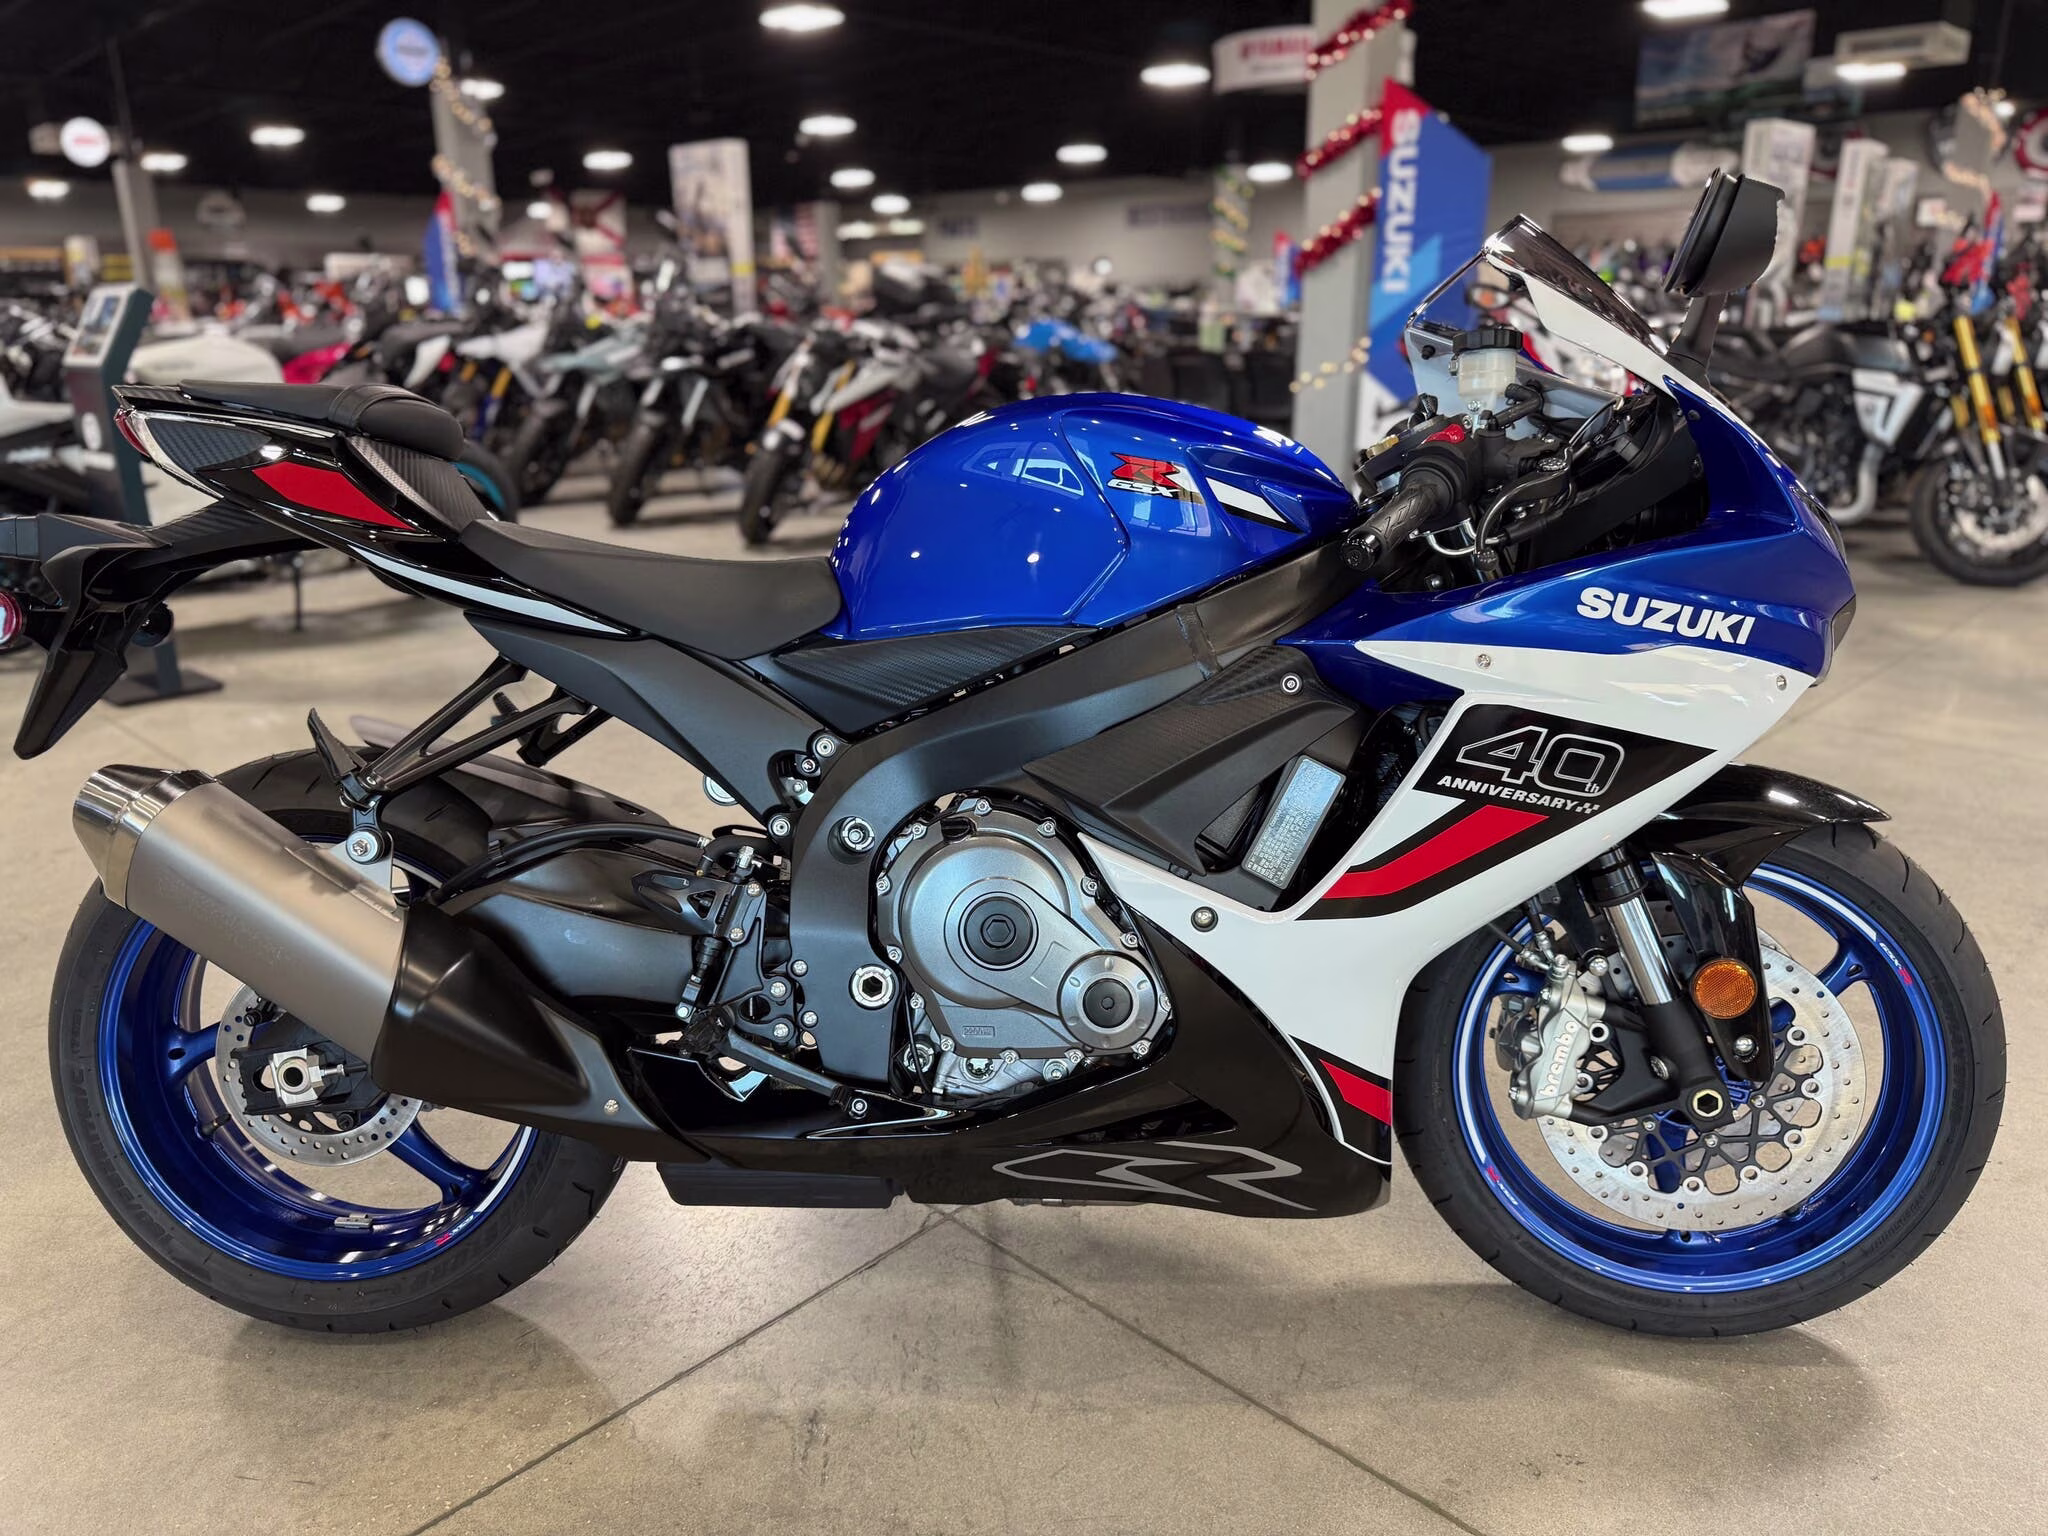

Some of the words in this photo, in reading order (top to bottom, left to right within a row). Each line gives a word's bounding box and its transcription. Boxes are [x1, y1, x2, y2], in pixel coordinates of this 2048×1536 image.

[1382, 107, 1422, 295] SUZUKI
[1106, 479, 1179, 498] GSX
[1576, 586, 1756, 645] SUZUKI
[1437, 775, 1580, 812] ANNIVERSARY
[1537, 1019, 1577, 1098] brembo
